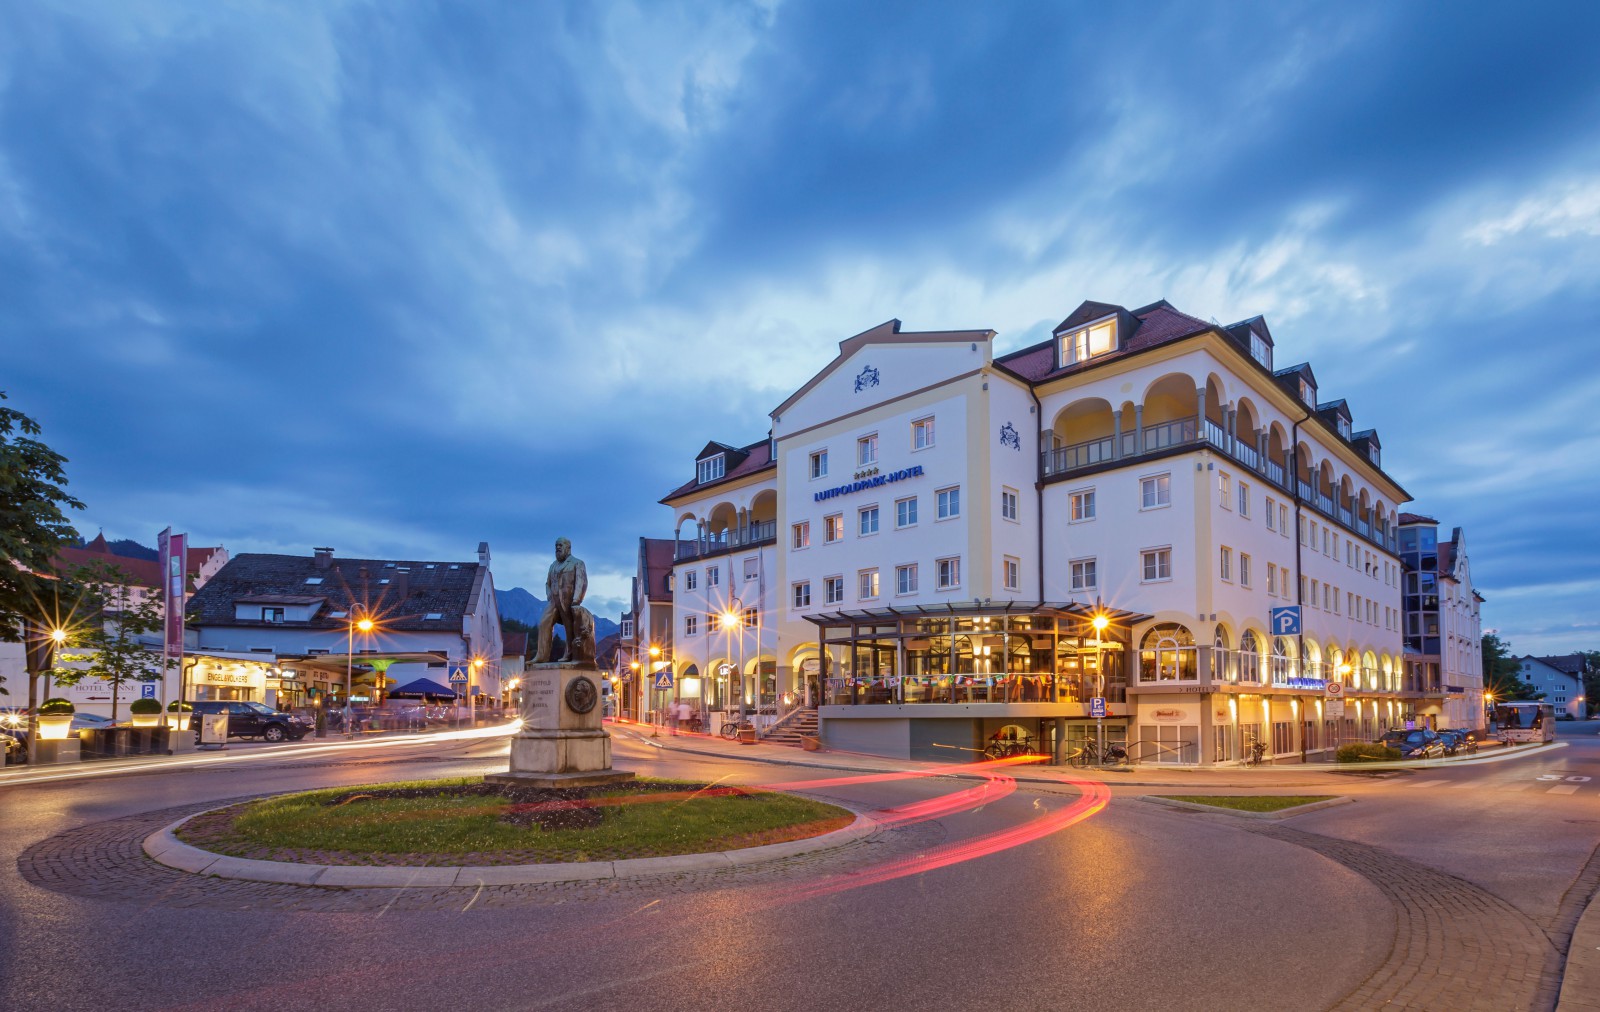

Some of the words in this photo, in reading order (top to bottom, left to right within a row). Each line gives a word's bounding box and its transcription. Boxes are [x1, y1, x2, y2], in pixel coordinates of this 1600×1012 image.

[814, 465, 924, 502] LUITPOLDPARK-HOTEL
[1281, 617, 1293, 633] P
[144, 686, 152, 695] P
[1093, 698, 1102, 708] P
